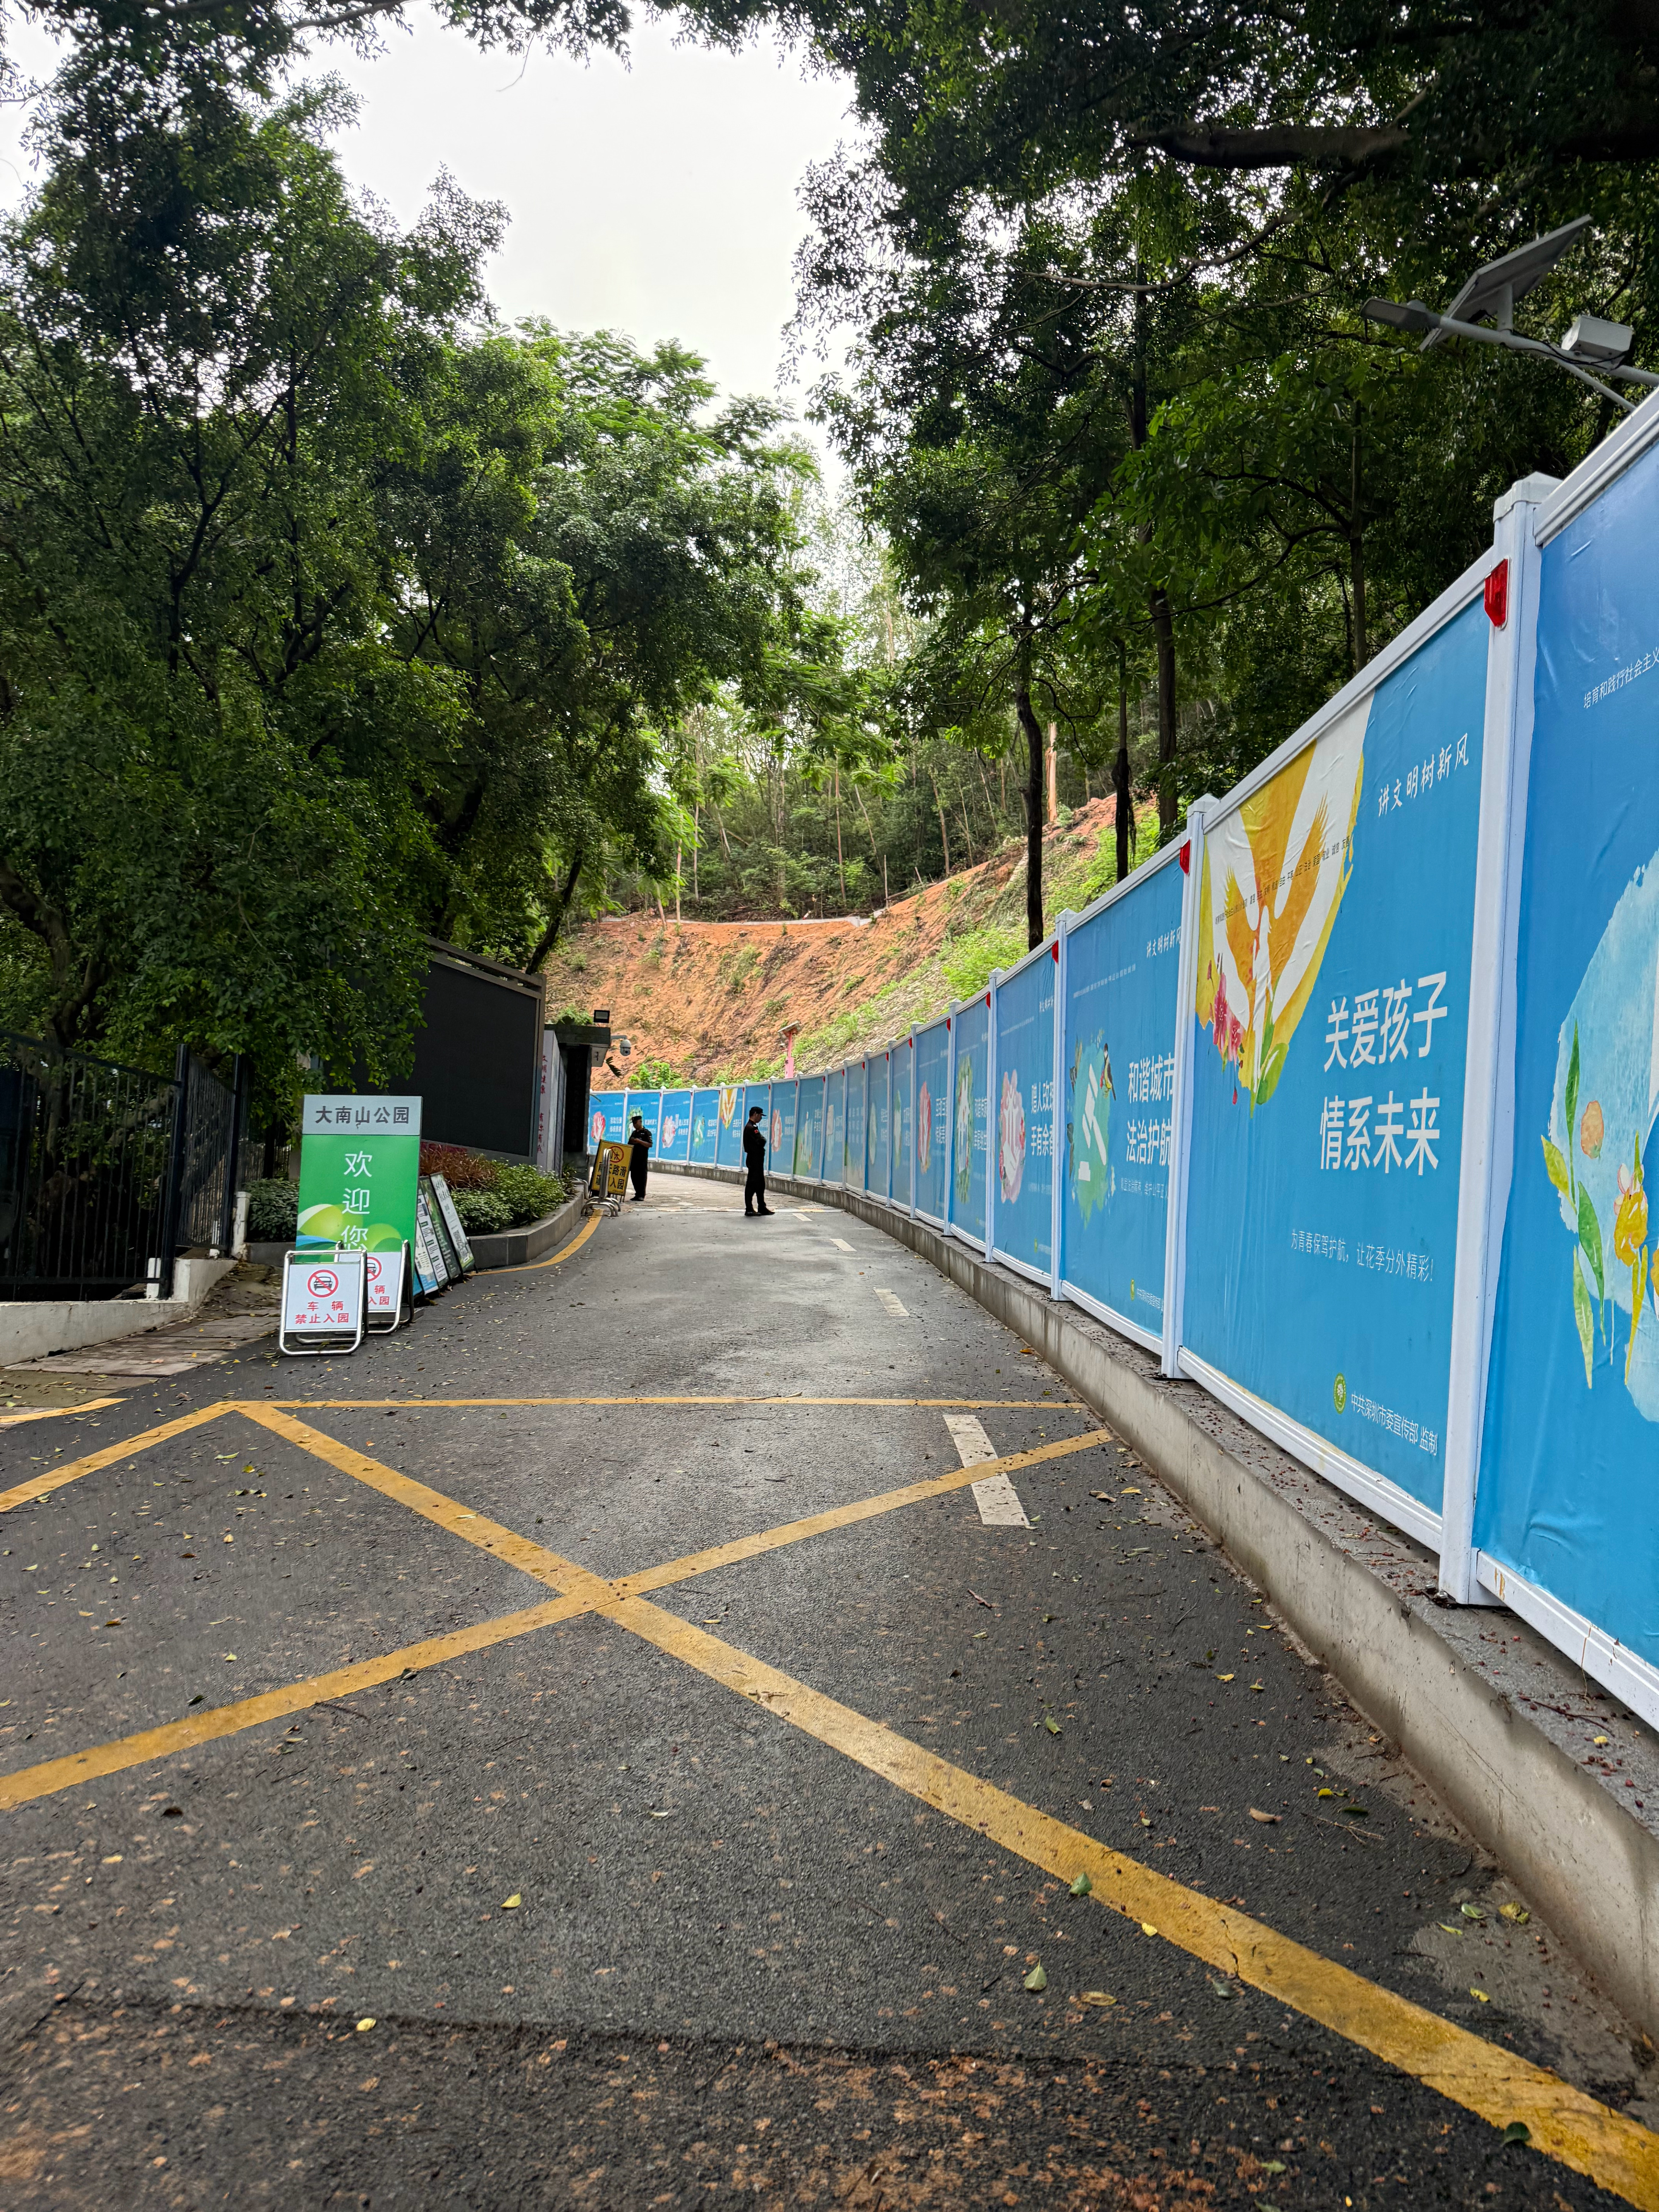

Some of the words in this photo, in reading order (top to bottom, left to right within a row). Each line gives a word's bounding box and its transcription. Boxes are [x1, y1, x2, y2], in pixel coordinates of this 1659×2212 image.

[1583, 646, 1659, 709] 培育和践行社会主义
[1378, 733, 1469, 817] 讲文明树新风
[1324, 971, 1448, 1072] 关爱孩子
[1128, 1052, 1174, 1103] 和谐城市
[315, 1106, 409, 1124] 大南山公园
[1127, 1118, 1171, 1166] 法治护航
[1320, 1087, 1440, 1175] 情系未来
[341, 1151, 372, 1250] 欢迎您
[295, 1313, 349, 1324] 禁止入园
[1351, 1391, 1419, 1444] 中共深圳市委宣传部
[1419, 1426, 1437, 1456] 监制
